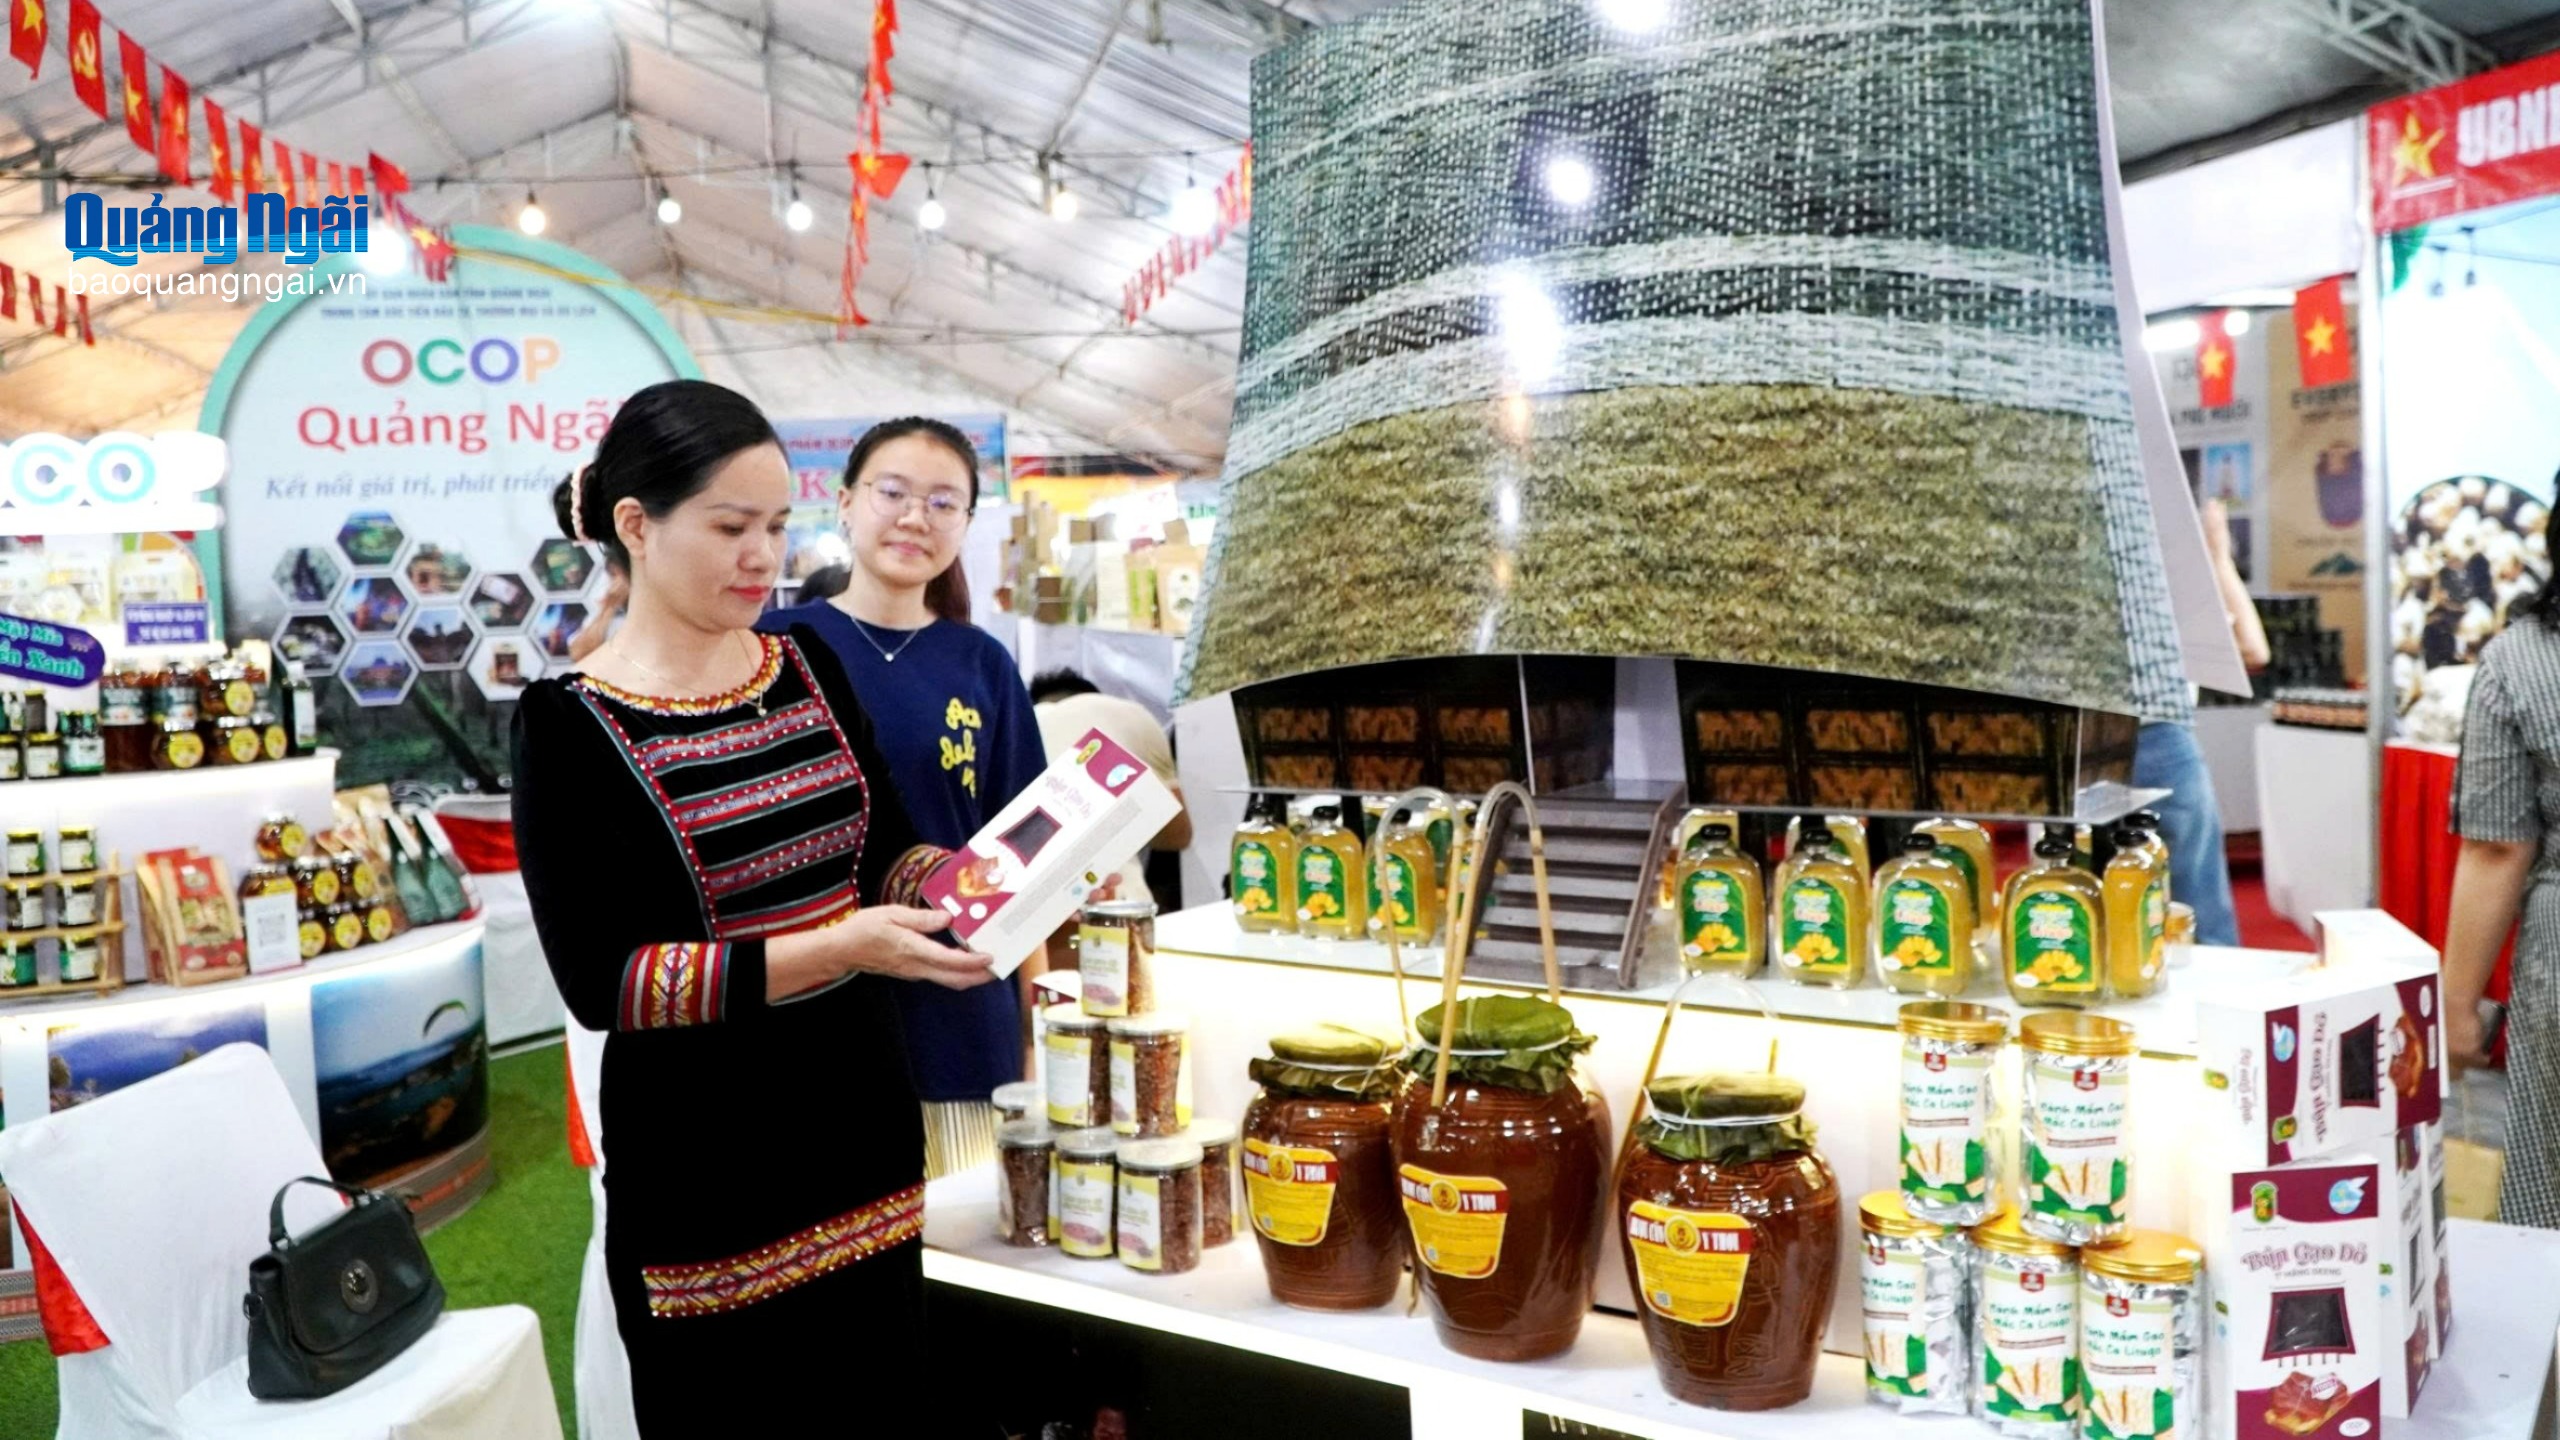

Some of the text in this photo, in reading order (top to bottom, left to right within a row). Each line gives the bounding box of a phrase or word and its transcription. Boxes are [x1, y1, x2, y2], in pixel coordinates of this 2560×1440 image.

[361, 337, 561, 387] OCOP
[298, 398, 625, 455] Quảng Ngã
[265, 473, 307, 500] Kết
[316, 470, 352, 497] nối
[360, 473, 394, 500] giá
[443, 471, 495, 498] phát
[25, 648, 85, 680] Xanh
